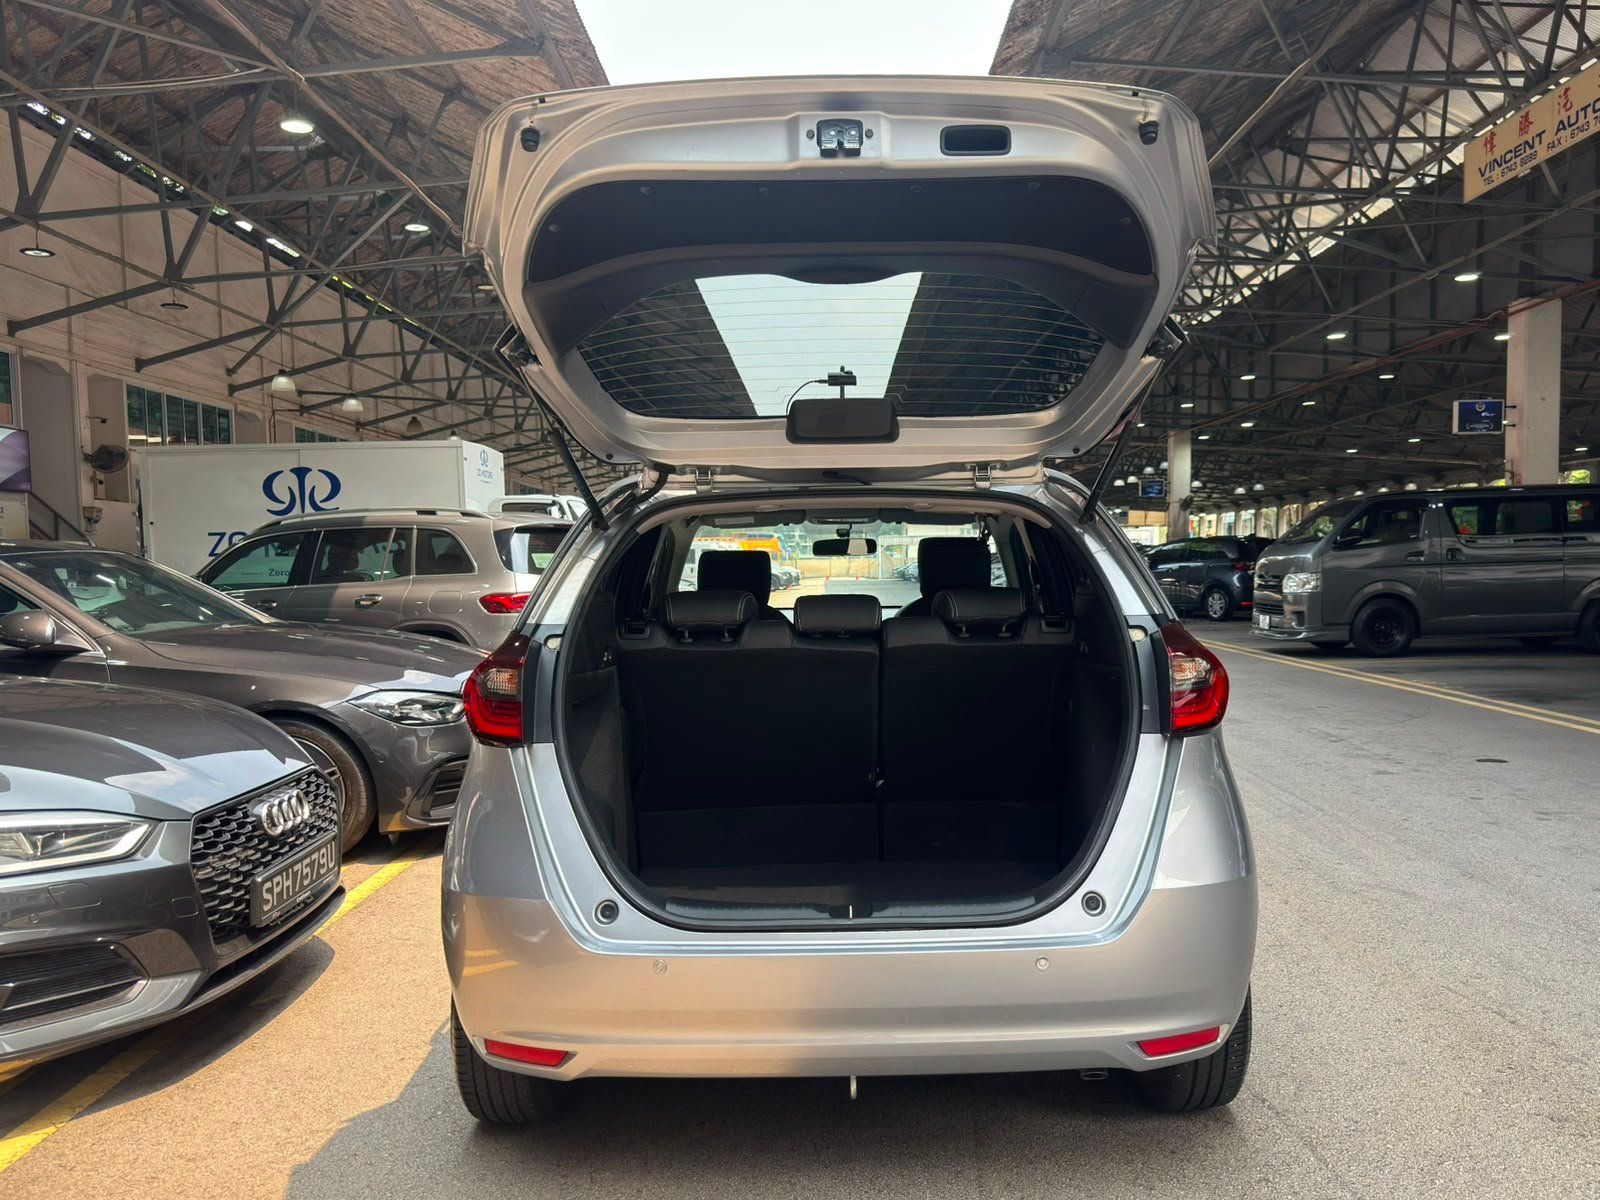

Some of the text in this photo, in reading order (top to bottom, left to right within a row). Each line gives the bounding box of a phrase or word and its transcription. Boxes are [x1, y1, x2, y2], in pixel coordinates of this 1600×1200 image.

[1478, 129, 1546, 178] VINCENT
[1501, 161, 1518, 177] 6743
[1547, 135, 1562, 152] FAX
[1570, 120, 1590, 139] 6743
[268, 568, 290, 577] Zero
[262, 841, 336, 912] SPH7579U
